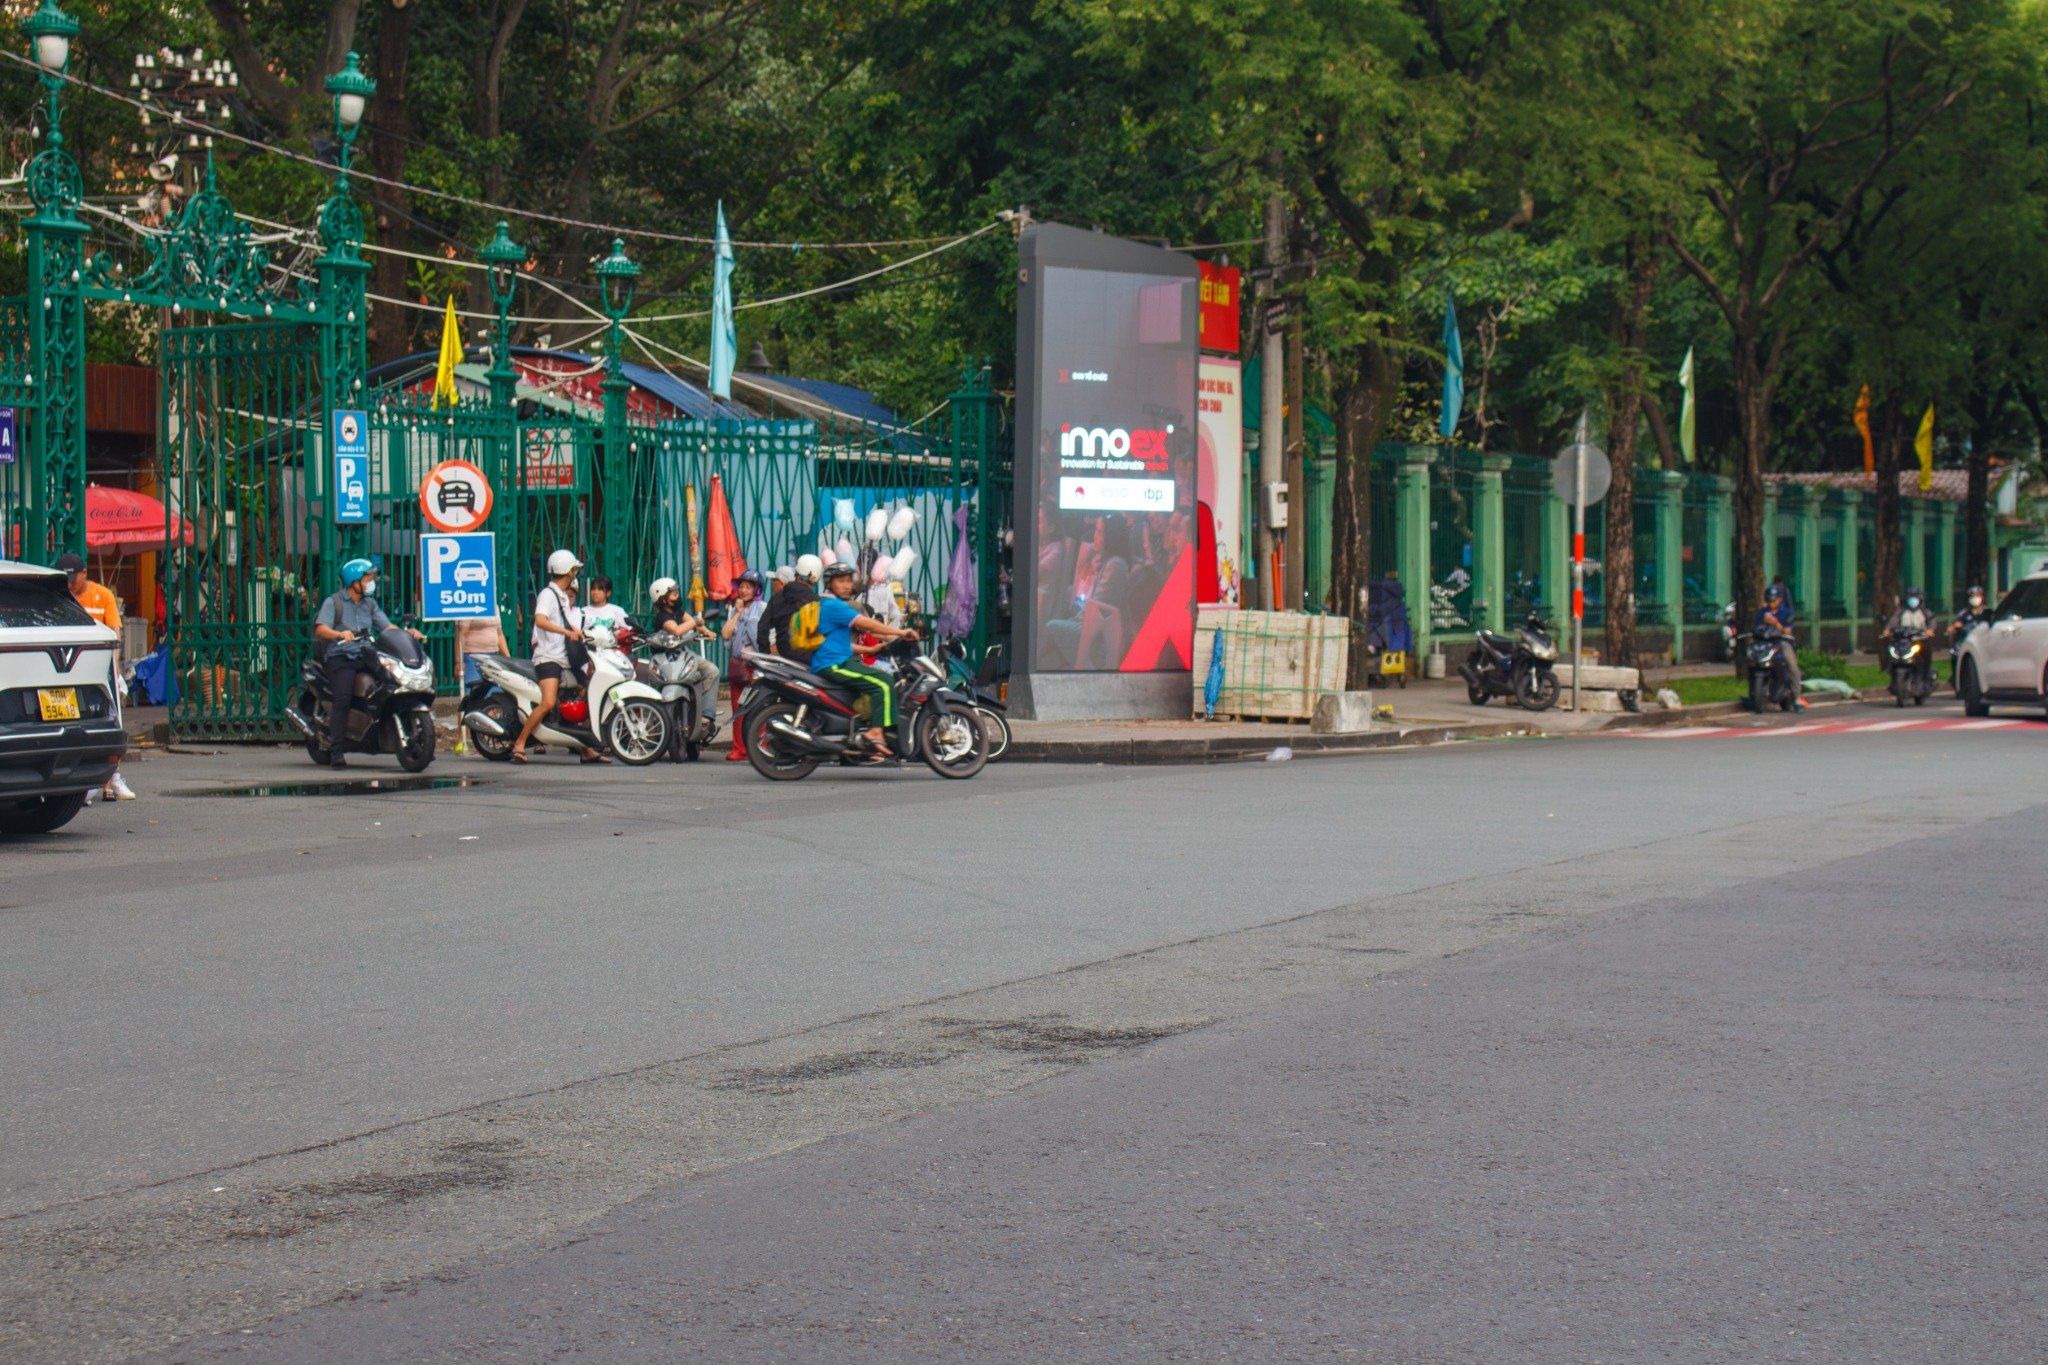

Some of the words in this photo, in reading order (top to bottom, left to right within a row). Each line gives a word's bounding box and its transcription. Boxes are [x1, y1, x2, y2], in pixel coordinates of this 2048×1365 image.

[340, 458, 356, 493] P
[427, 538, 460, 584] P
[440, 590, 486, 605] 50m
